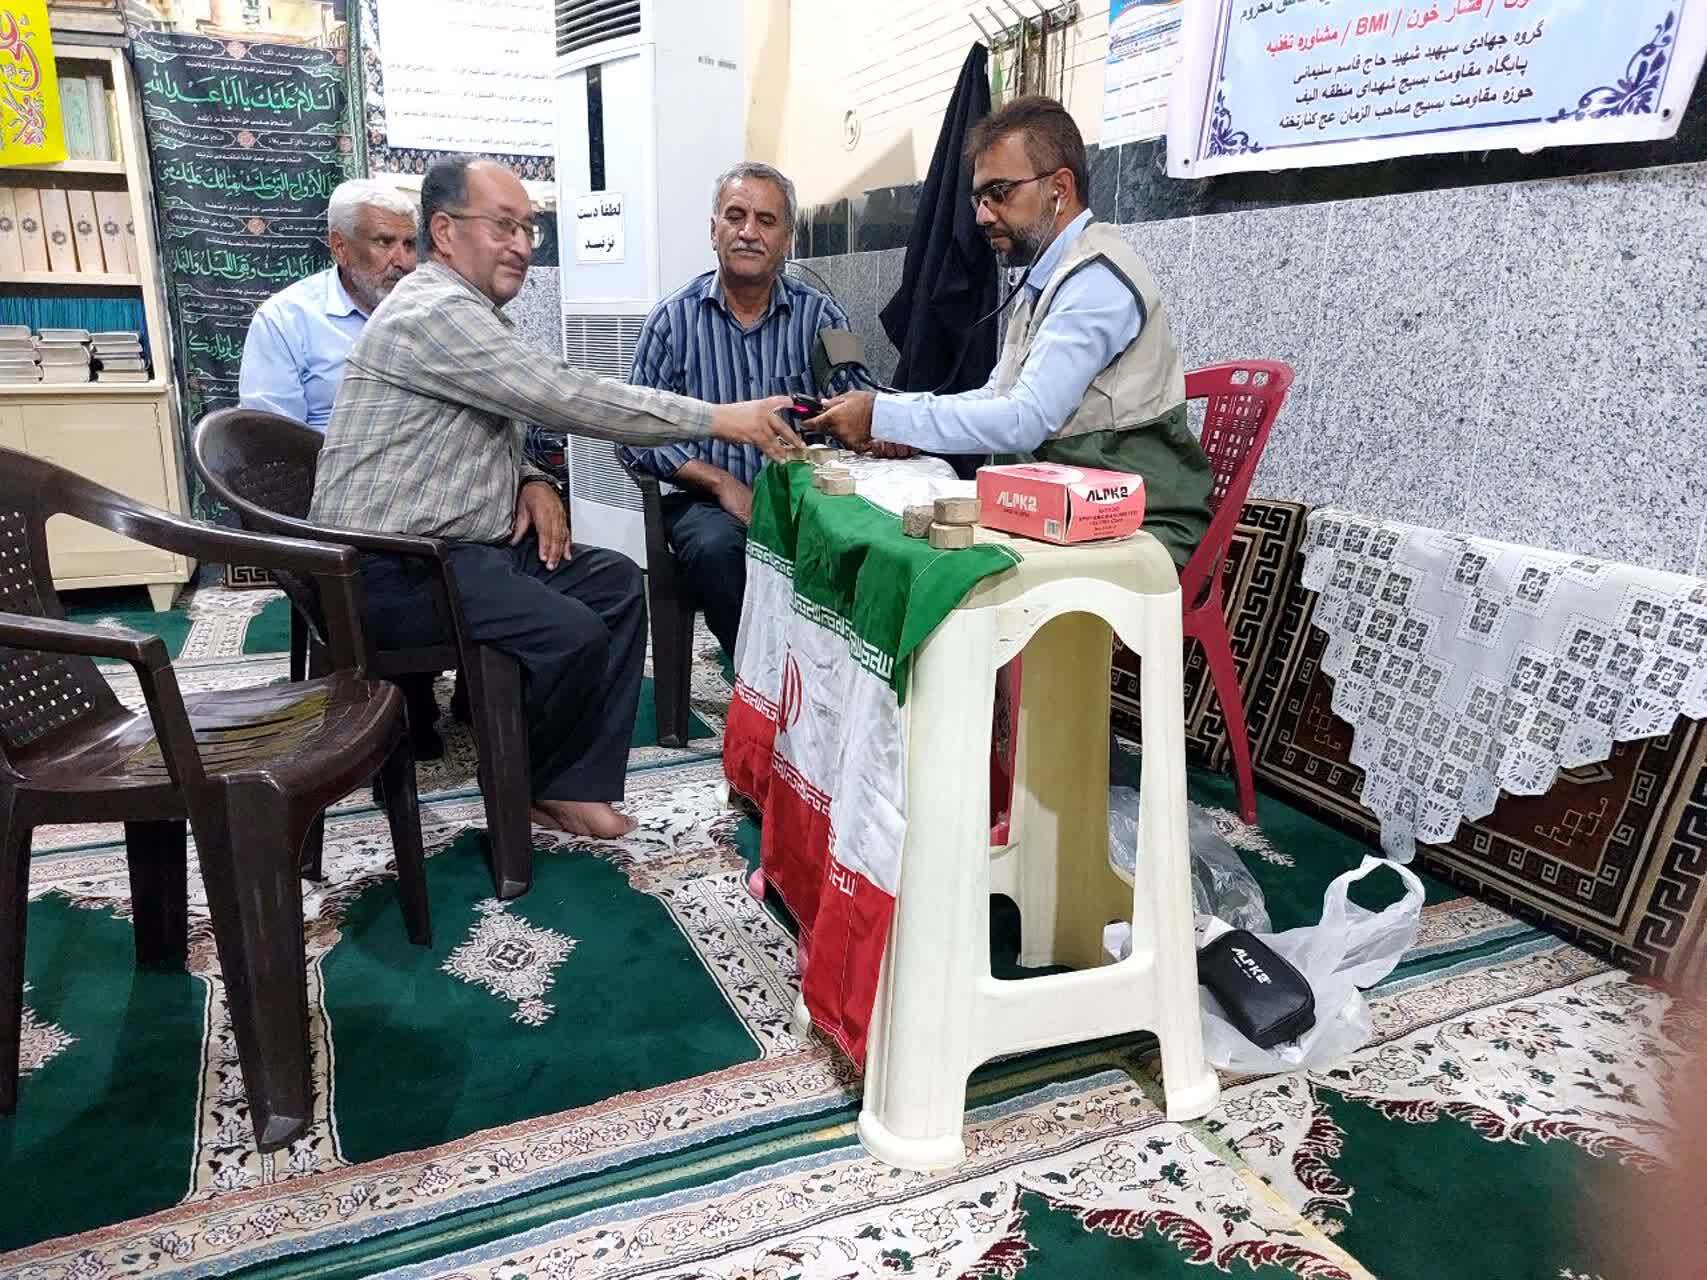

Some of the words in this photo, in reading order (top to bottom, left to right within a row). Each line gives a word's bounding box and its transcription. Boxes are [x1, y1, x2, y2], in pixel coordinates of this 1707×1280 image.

[1354, 13, 1389, 36] BMI
[1406, 4, 1440, 28] خون
[1298, 25, 1338, 51] مشاوره
[1462, 32, 1508, 54] جهادی
[1514, 19, 1545, 46] گروه
[1334, 54, 1361, 78] قاسم
[1362, 53, 1387, 74] حاج
[1392, 45, 1421, 66] شهید
[1486, 54, 1528, 76] پایگاه
[1293, 60, 1333, 84] سلیمانی
[1434, 62, 1482, 83] مقاومت
[1322, 82, 1353, 99] منطقه
[1356, 75, 1396, 98] شهدای
[1399, 76, 1430, 94] بسیج
[1449, 87, 1497, 108] مقاومت
[1502, 87, 1534, 105] حوزه
[1340, 104, 1371, 125] الزمان
[1375, 101, 1411, 120] صاحب
[1413, 100, 1445, 118] بسیج
[576, 207, 599, 220] دست
[995, 490, 1039, 512] ALPK2
[1085, 486, 1128, 502] ALPK2
